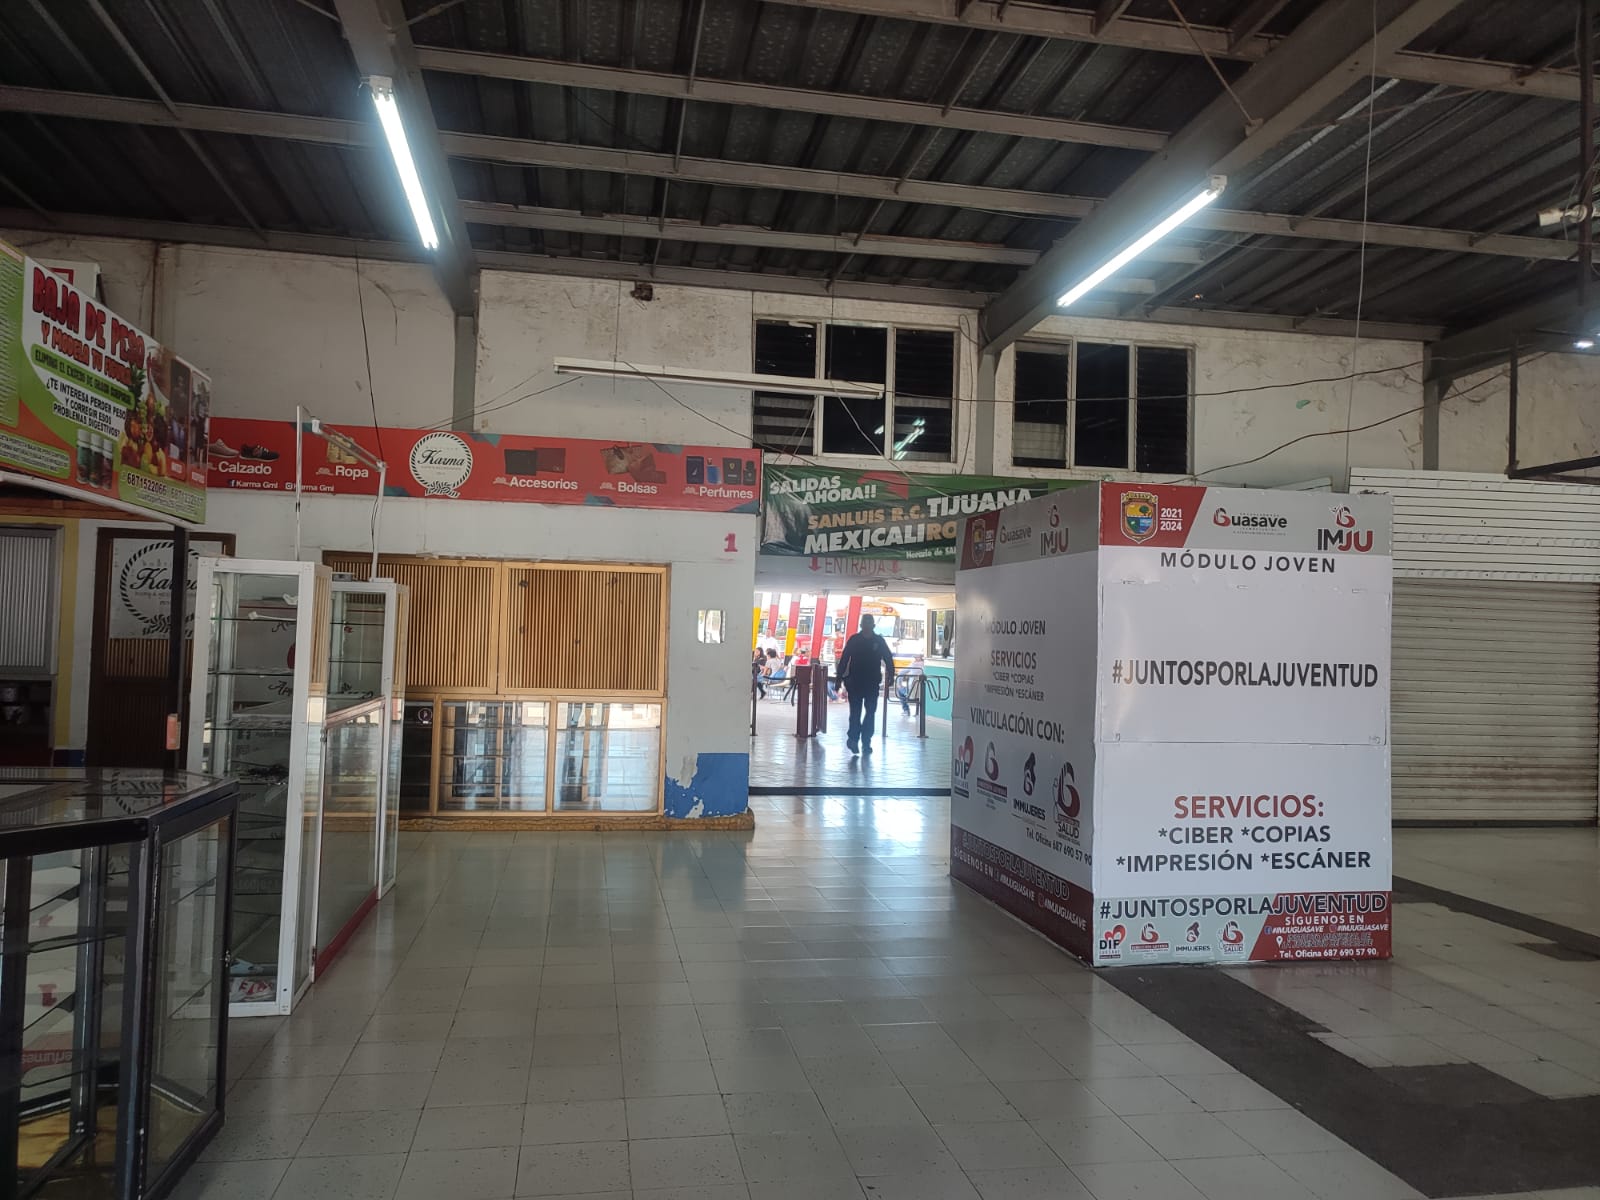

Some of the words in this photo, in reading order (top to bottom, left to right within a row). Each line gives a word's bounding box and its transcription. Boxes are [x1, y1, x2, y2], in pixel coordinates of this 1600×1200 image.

[33, 267, 80, 334] BAJA
[85, 302, 106, 349] DE
[111, 318, 145, 368] PESO
[41, 320, 50, 344] Y
[52, 326, 89, 367] MODELA
[60, 382, 89, 404] INTERESA
[91, 395, 112, 414] PERDER
[113, 405, 126, 420] PESO
[53, 403, 87, 425] PROBLEMAS
[70, 400, 98, 419] CORREGIR
[99, 412, 112, 425] ESOS
[417, 449, 466, 466] Karma
[218, 461, 272, 475] Calzado
[336, 465, 369, 480] Ropa
[236, 480, 261, 488] Karma
[510, 476, 578, 490] Accesorios
[618, 482, 657, 494] Bolsas
[699, 486, 753, 499] Perfumes
[769, 475, 841, 495] SALIDAS
[803, 484, 877, 504] AHORA!!
[1160, 508, 1182, 519] 2021
[1213, 507, 1288, 528] Guasave
[1160, 520, 1183, 531] 2024
[724, 533, 738, 552] 1
[1040, 527, 1069, 556] IMJU
[1318, 528, 1373, 552] IMJU
[933, 548, 943, 556] de
[1160, 550, 1256, 571] MÓDULO
[1264, 556, 1335, 573] JOVEN
[824, 557, 886, 575] ENTRADA
[1018, 620, 1046, 635] JOVEN
[991, 650, 1037, 669] SERVICIOS
[1112, 660, 1378, 687] #JUNTOSPORLAJUVENTUD
[970, 707, 1035, 739] VINCULACIÓN
[1036, 719, 1065, 744] CON:
[954, 759, 970, 780] DIF
[1174, 794, 1324, 819] SERVICIOS:
[1057, 821, 1080, 839] SALUD
[1075, 851, 1084, 864] 57
[1084, 853, 1092, 866] 90
[1100, 894, 1386, 919] #JUNTOSPORLAJUVENTUD
[1285, 914, 1345, 926] SÍGUENOS
[1349, 915, 1364, 924] EN
[1099, 939, 1120, 950] DIF
[1280, 950, 1293, 959] Tel.
[1295, 950, 1322, 958] Oficina
[1323, 949, 1337, 957] 687
[1355, 948, 1365, 956] 57
[1367, 948, 1377, 956] 90
